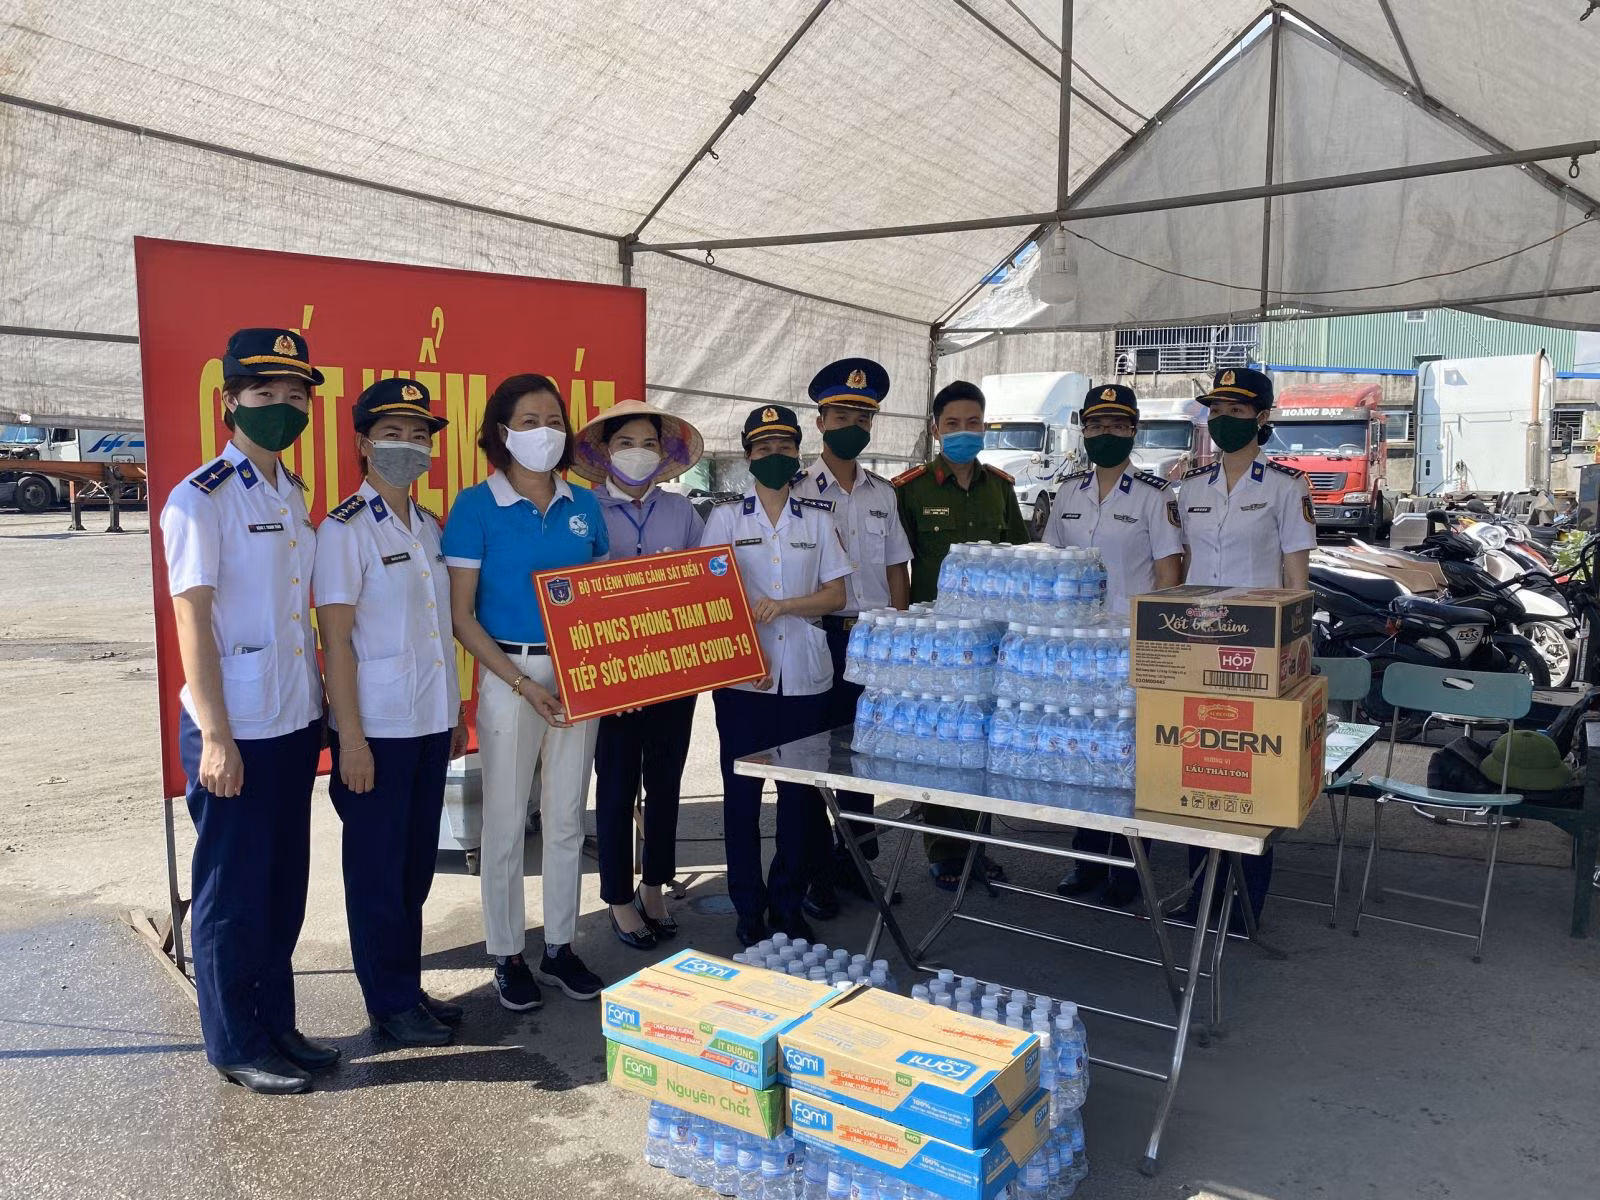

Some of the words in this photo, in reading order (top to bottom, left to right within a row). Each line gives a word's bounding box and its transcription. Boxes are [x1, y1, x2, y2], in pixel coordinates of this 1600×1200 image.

[1321, 408, 1344, 418] ĐẠT
[578, 578, 591, 597] BỘ
[590, 576, 602, 592] TƯ
[602, 574, 624, 593] LỆNH
[623, 570, 645, 587] VÙNG
[645, 564, 666, 584] CẢNH
[666, 564, 681, 580] SÁT
[681, 558, 699, 578] BIỂN
[700, 562, 704, 574] 1
[568, 619, 594, 654] HỘI
[594, 616, 630, 646] PNCS
[630, 606, 673, 638] PHÒNG
[672, 603, 706, 630] THAM
[706, 596, 733, 624] MƯU
[568, 656, 598, 692] TIẾP
[600, 653, 627, 686] SỨC
[628, 644, 672, 680] CHỐNG
[670, 643, 700, 674] DỊCH
[700, 633, 752, 664] COVID-19
[1222, 652, 1252, 670] HỘP
[1155, 724, 1282, 756] MODERN
[682, 960, 732, 976] Fami
[608, 1004, 634, 1024] Fami
[625, 1058, 652, 1077] Fami
[734, 1060, 758, 1074] 30%
[786, 1049, 818, 1072] Fami
[906, 1056, 970, 1077] Fami
[666, 1078, 716, 1106] Nguyên
[720, 1096, 751, 1118] Chất
[795, 1103, 827, 1126] Fami
